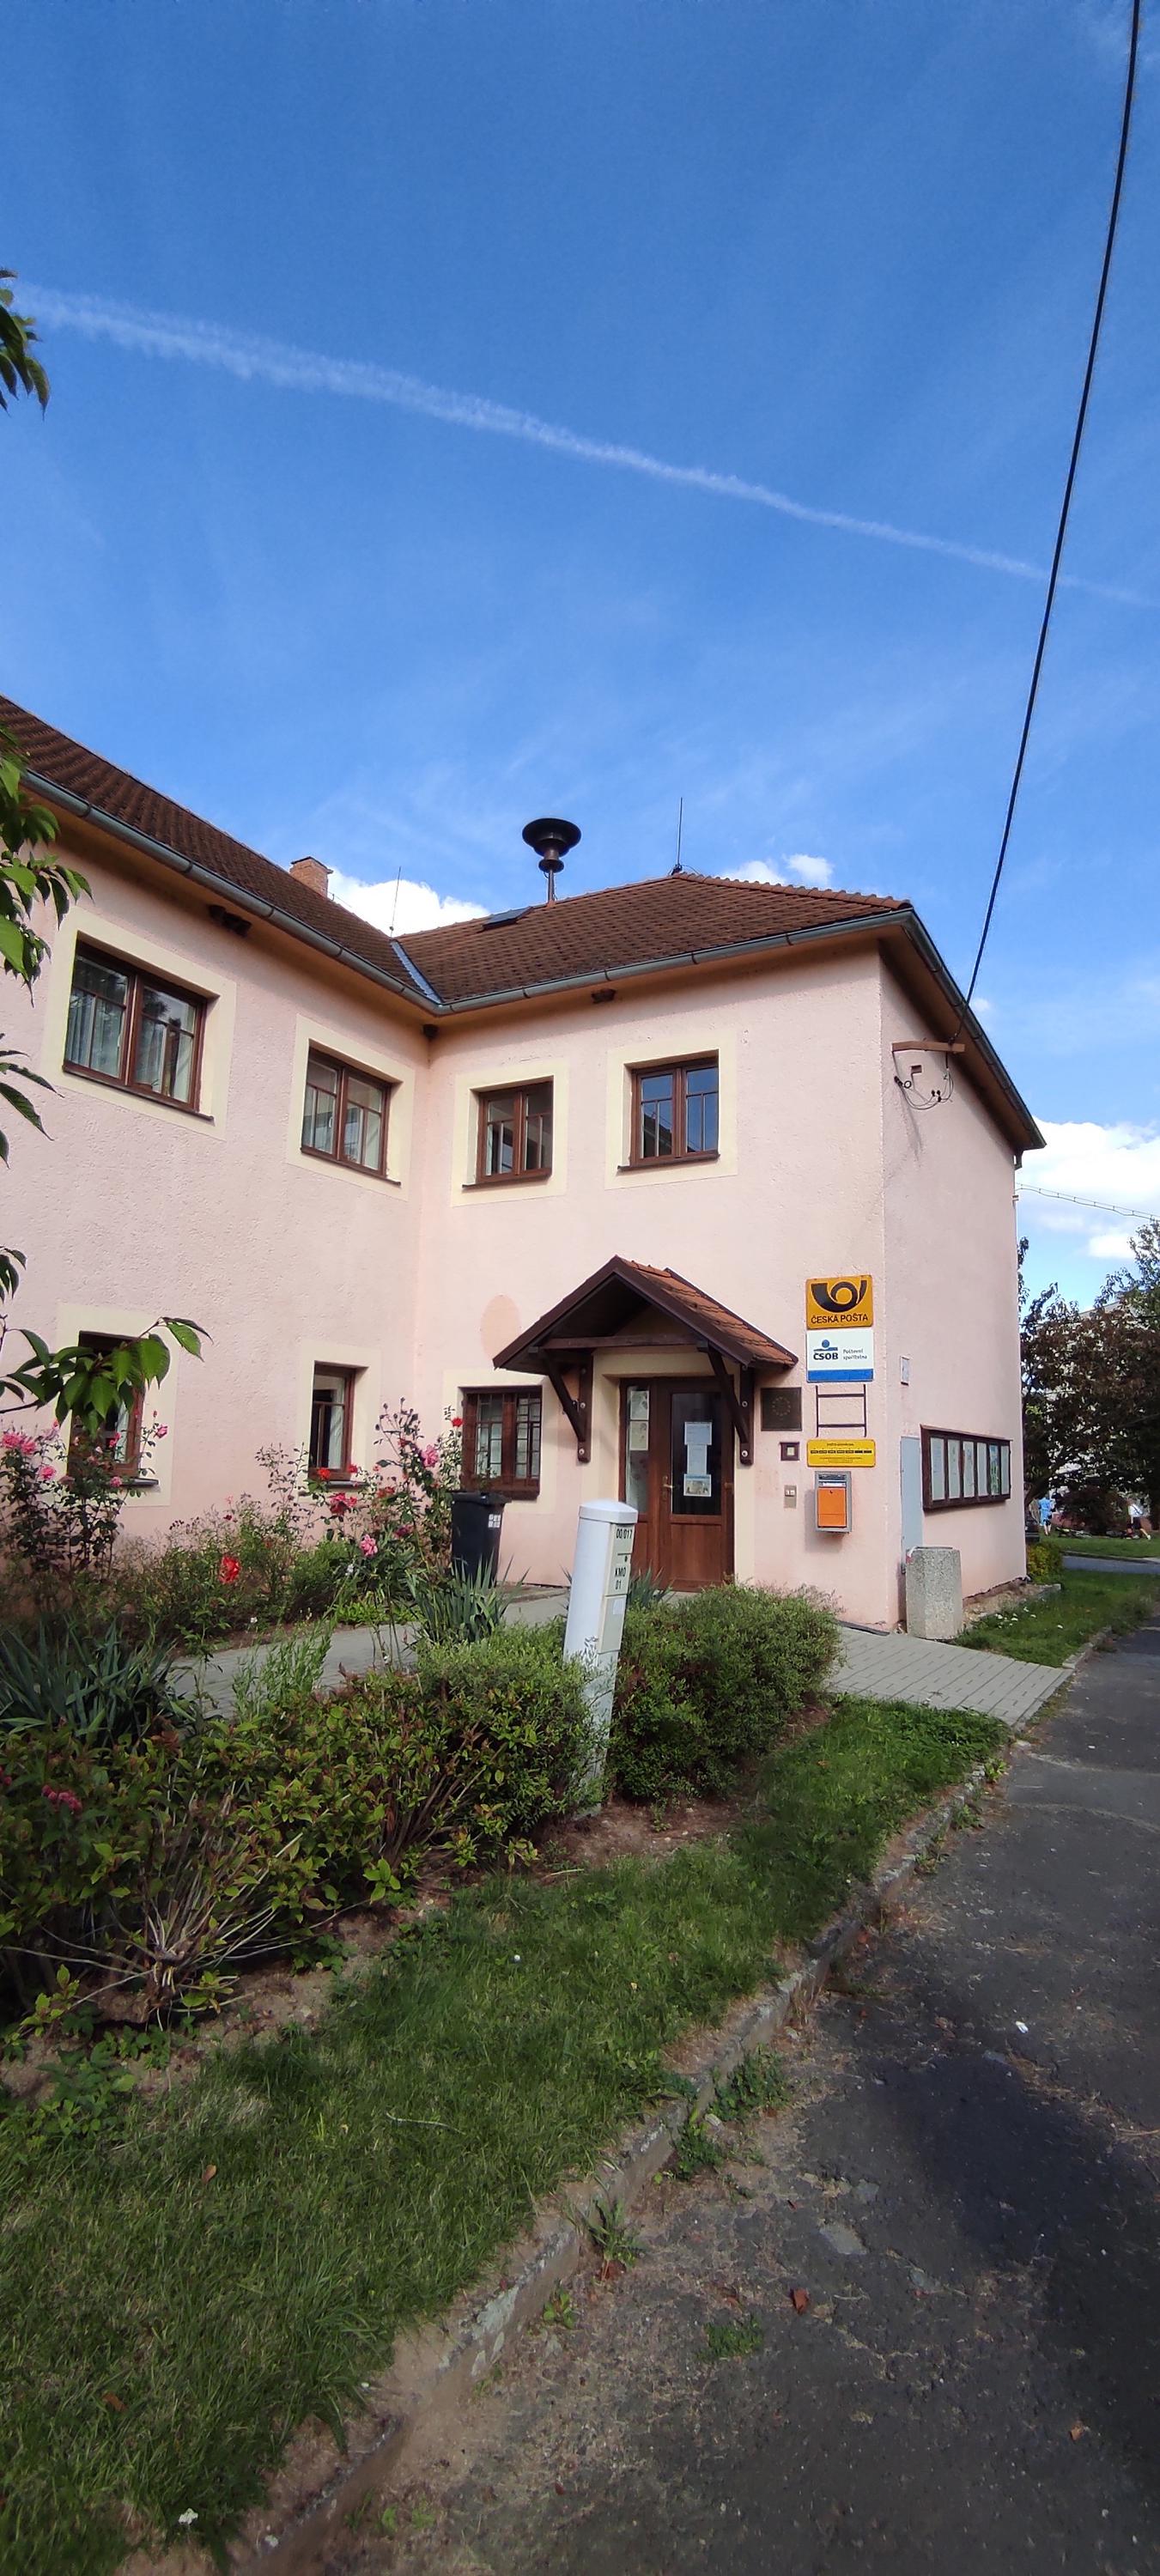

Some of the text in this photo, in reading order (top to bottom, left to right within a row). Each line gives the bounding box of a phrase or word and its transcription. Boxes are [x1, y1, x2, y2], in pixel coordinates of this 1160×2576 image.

[811, 1313, 868, 1324] ČESKÁ POŠTA
[813, 1352, 839, 1361] ČSOB
